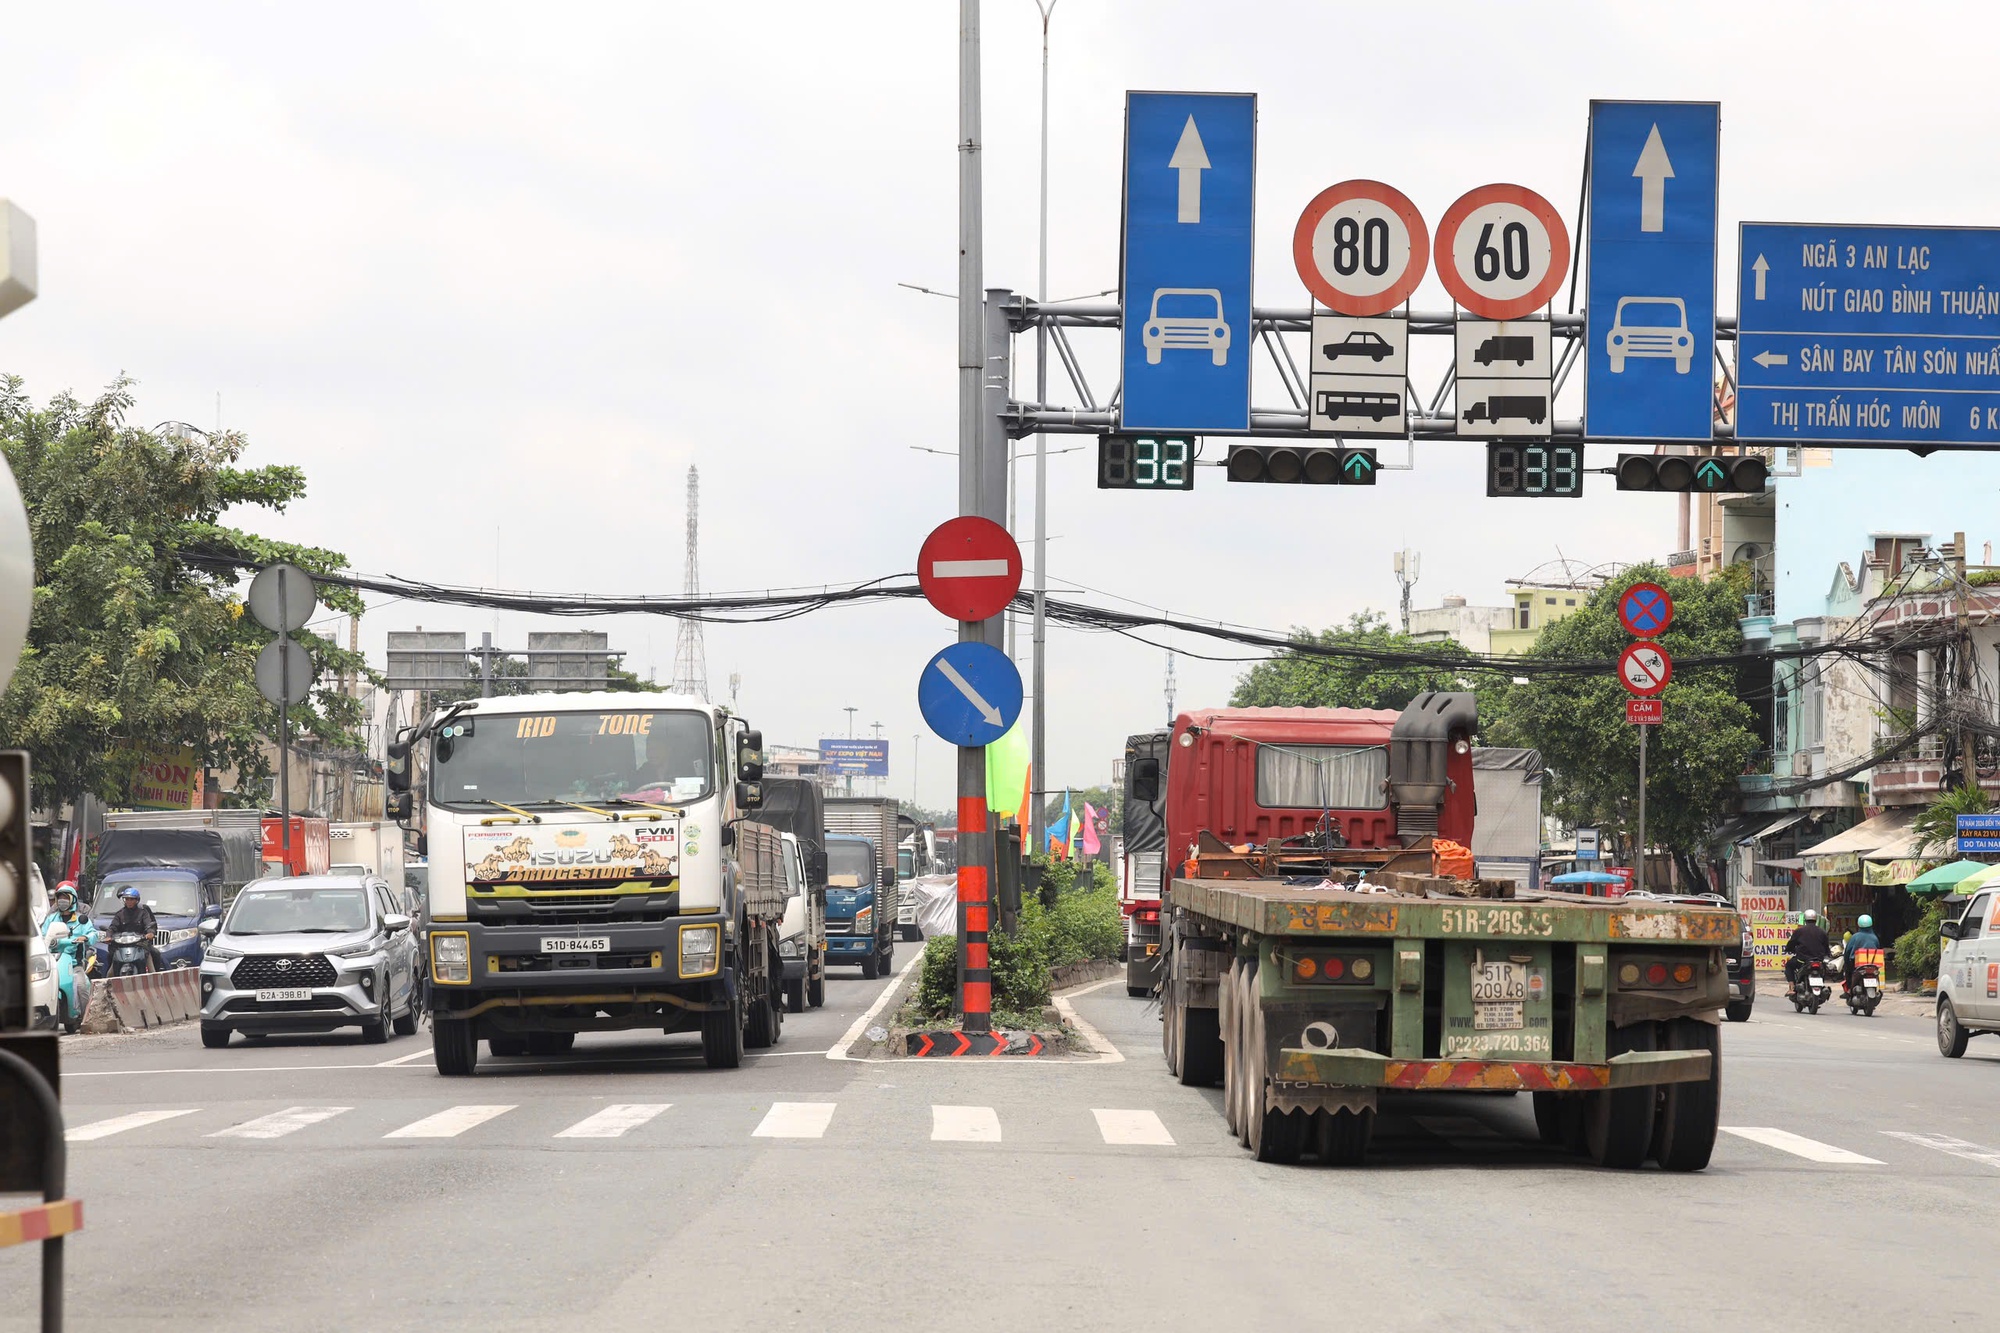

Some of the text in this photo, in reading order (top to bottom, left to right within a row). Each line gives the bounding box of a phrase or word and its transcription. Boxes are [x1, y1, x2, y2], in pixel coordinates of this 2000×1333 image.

[1333, 216, 1389, 277] 80
[1474, 221, 1530, 282] 60
[1802, 239, 1930, 275] NGÃ 3 AN LẠC
[1801, 281, 1999, 320] NÚT GIAO BÌNH THUẬN
[1800, 343, 2000, 376] SÂN BAY TÂN SƠN NHẤ
[1771, 394, 2000, 432] THỊ TRẤN HÓC MÔN 6 K
[1135, 439, 1188, 485] 32
[1525, 447, 1577, 493] 33
[1633, 700, 1653, 712] CẤM
[598, 714, 654, 735] TONE
[1988, 841, 2000, 849] NẠ
[530, 849, 612, 865] ISUZU
[505, 865, 636, 881] BRIDGESTONE
[1741, 898, 1785, 910] HONDA
[1756, 925, 1774, 939] BÚN
[546, 939, 605, 951] 51D-844.65
[1754, 945, 1779, 955] CANH
[1755, 958, 1772, 967] 25K
[1484, 965, 1513, 982] 51R
[260, 990, 307, 1000] 62A-398.81
[1474, 982, 1524, 999] 209.48
